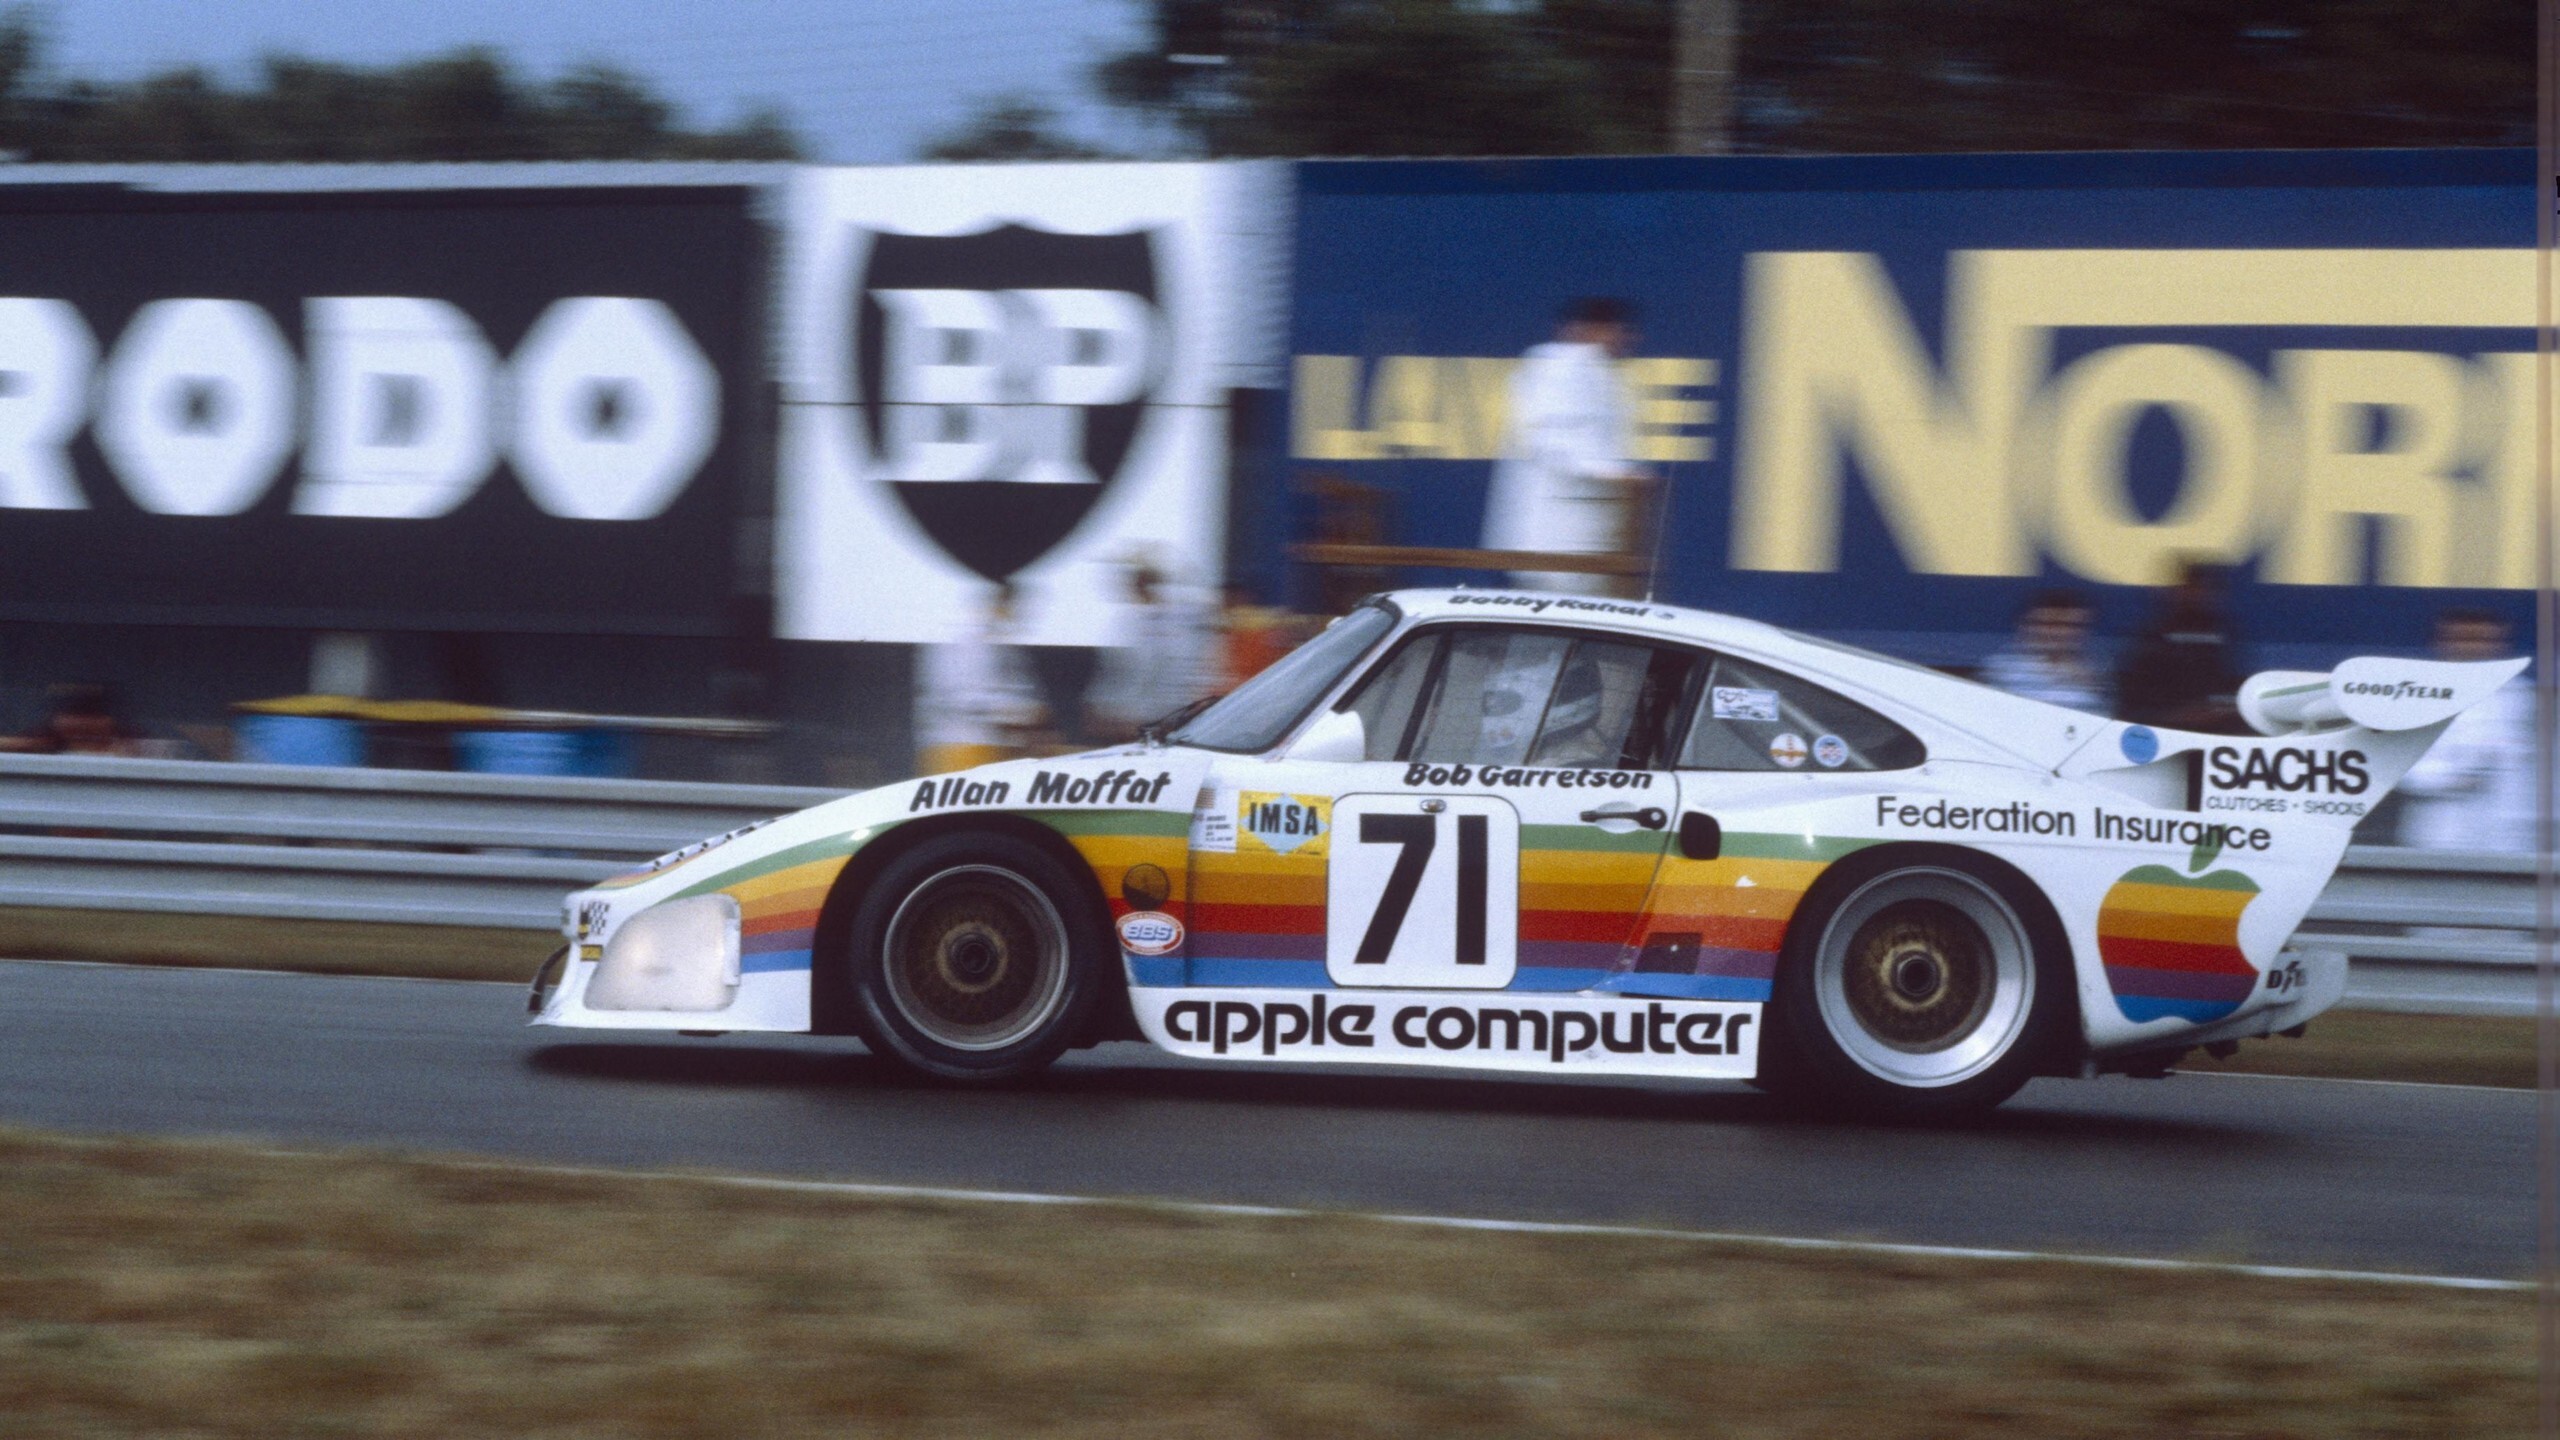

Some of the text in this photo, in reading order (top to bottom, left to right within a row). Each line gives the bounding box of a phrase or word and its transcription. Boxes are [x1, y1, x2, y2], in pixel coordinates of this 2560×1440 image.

[866, 288, 1164, 483] BP
[1449, 594, 1553, 613] Bobby
[2343, 680, 2454, 700] GOODYEAR
[1403, 761, 1654, 791] Bob Garretson
[2208, 746, 2370, 796] SACHS
[908, 769, 1171, 812] Allan Moffat
[2206, 795, 2288, 813] CLUTCHES
[1248, 802, 1319, 836] IMSA
[1876, 795, 2272, 852] Federation Insurance
[1353, 812, 1490, 966] 71
[1126, 924, 1173, 941] BBS
[1163, 993, 1753, 1064] apple computer
